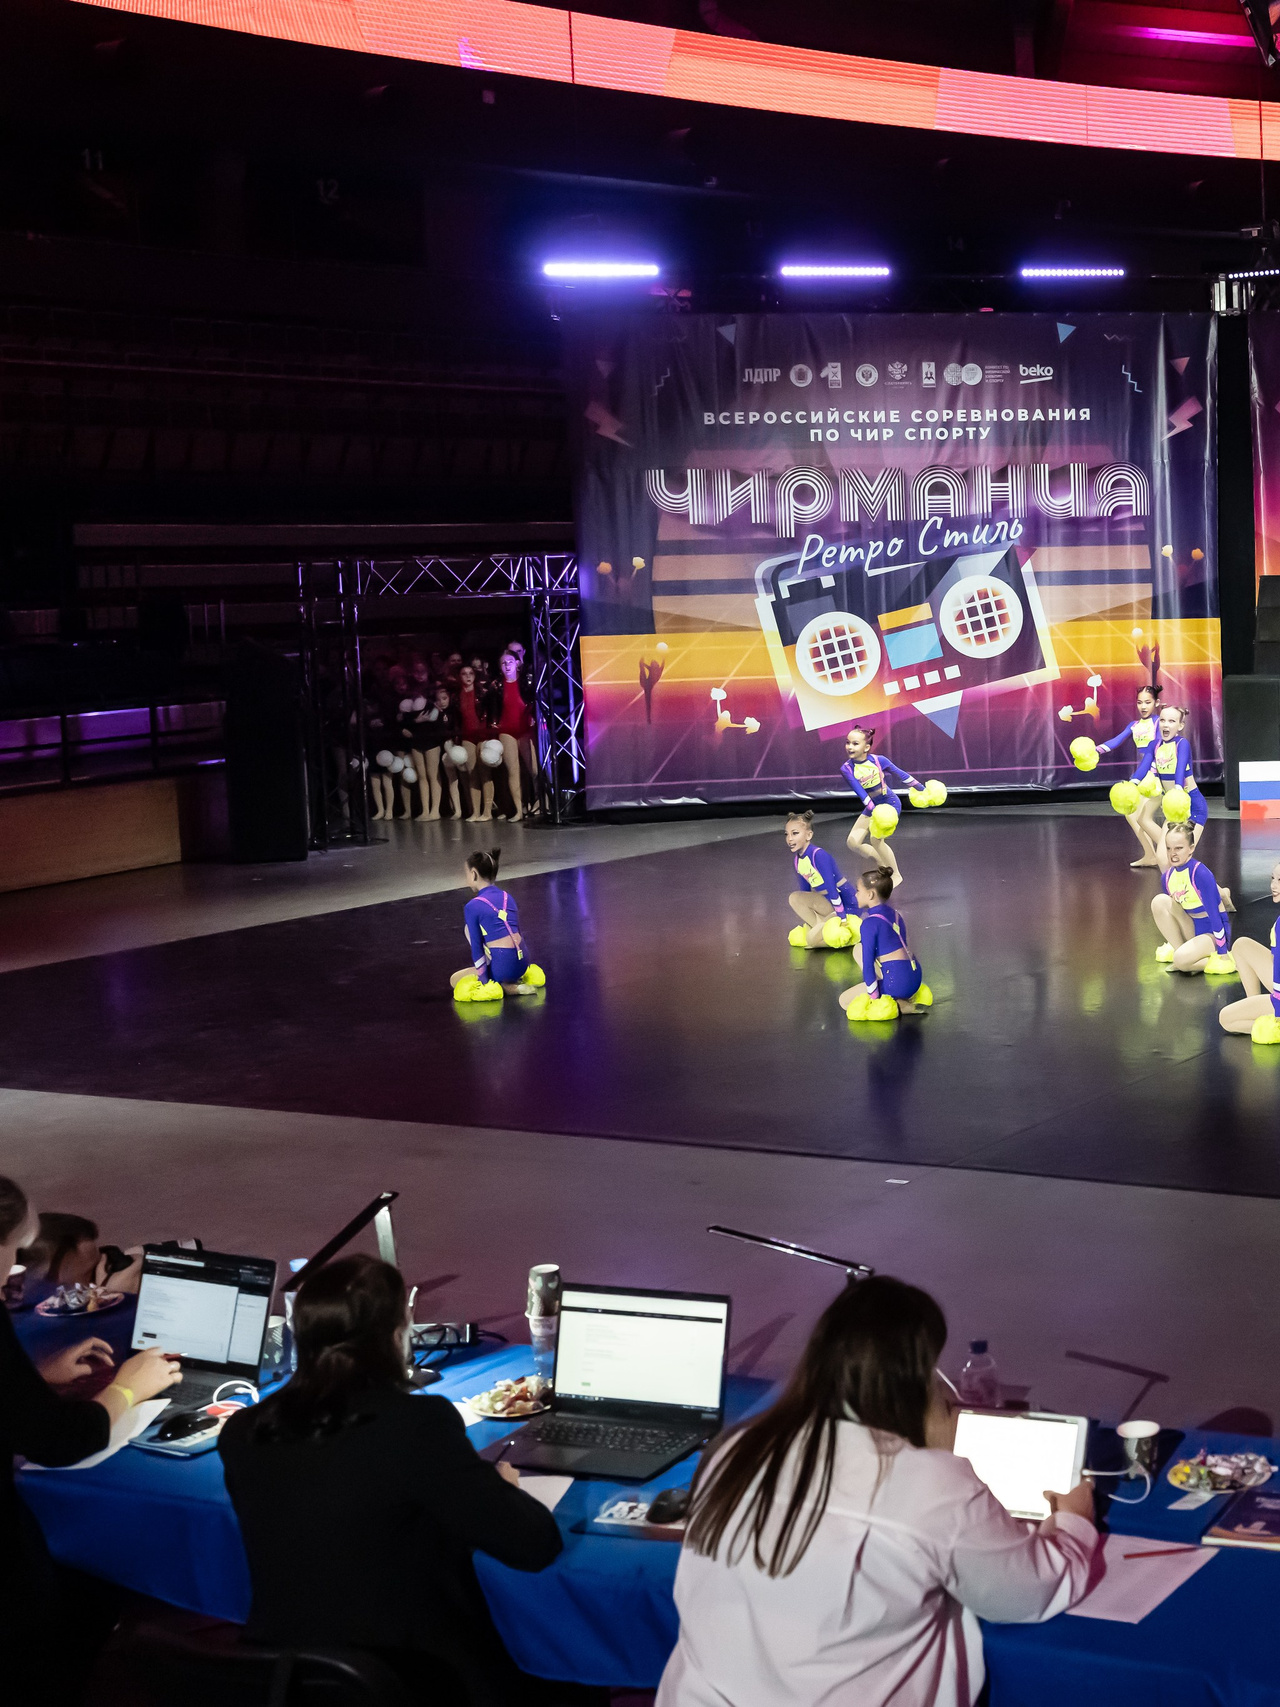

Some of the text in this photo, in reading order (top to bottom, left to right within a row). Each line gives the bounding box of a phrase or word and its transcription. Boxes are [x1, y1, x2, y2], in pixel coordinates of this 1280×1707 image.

[743, 368, 781, 385] ЛДПР
[1020, 364, 1054, 377] beko
[704, 405, 1092, 425] ВСЕРОССИЙСКИЕ СОРЕВНОВАНИЯ
[809, 426, 991, 442] ПО ЧИР СПОРТУ
[798, 516, 1024, 576] Ретро Стиль
